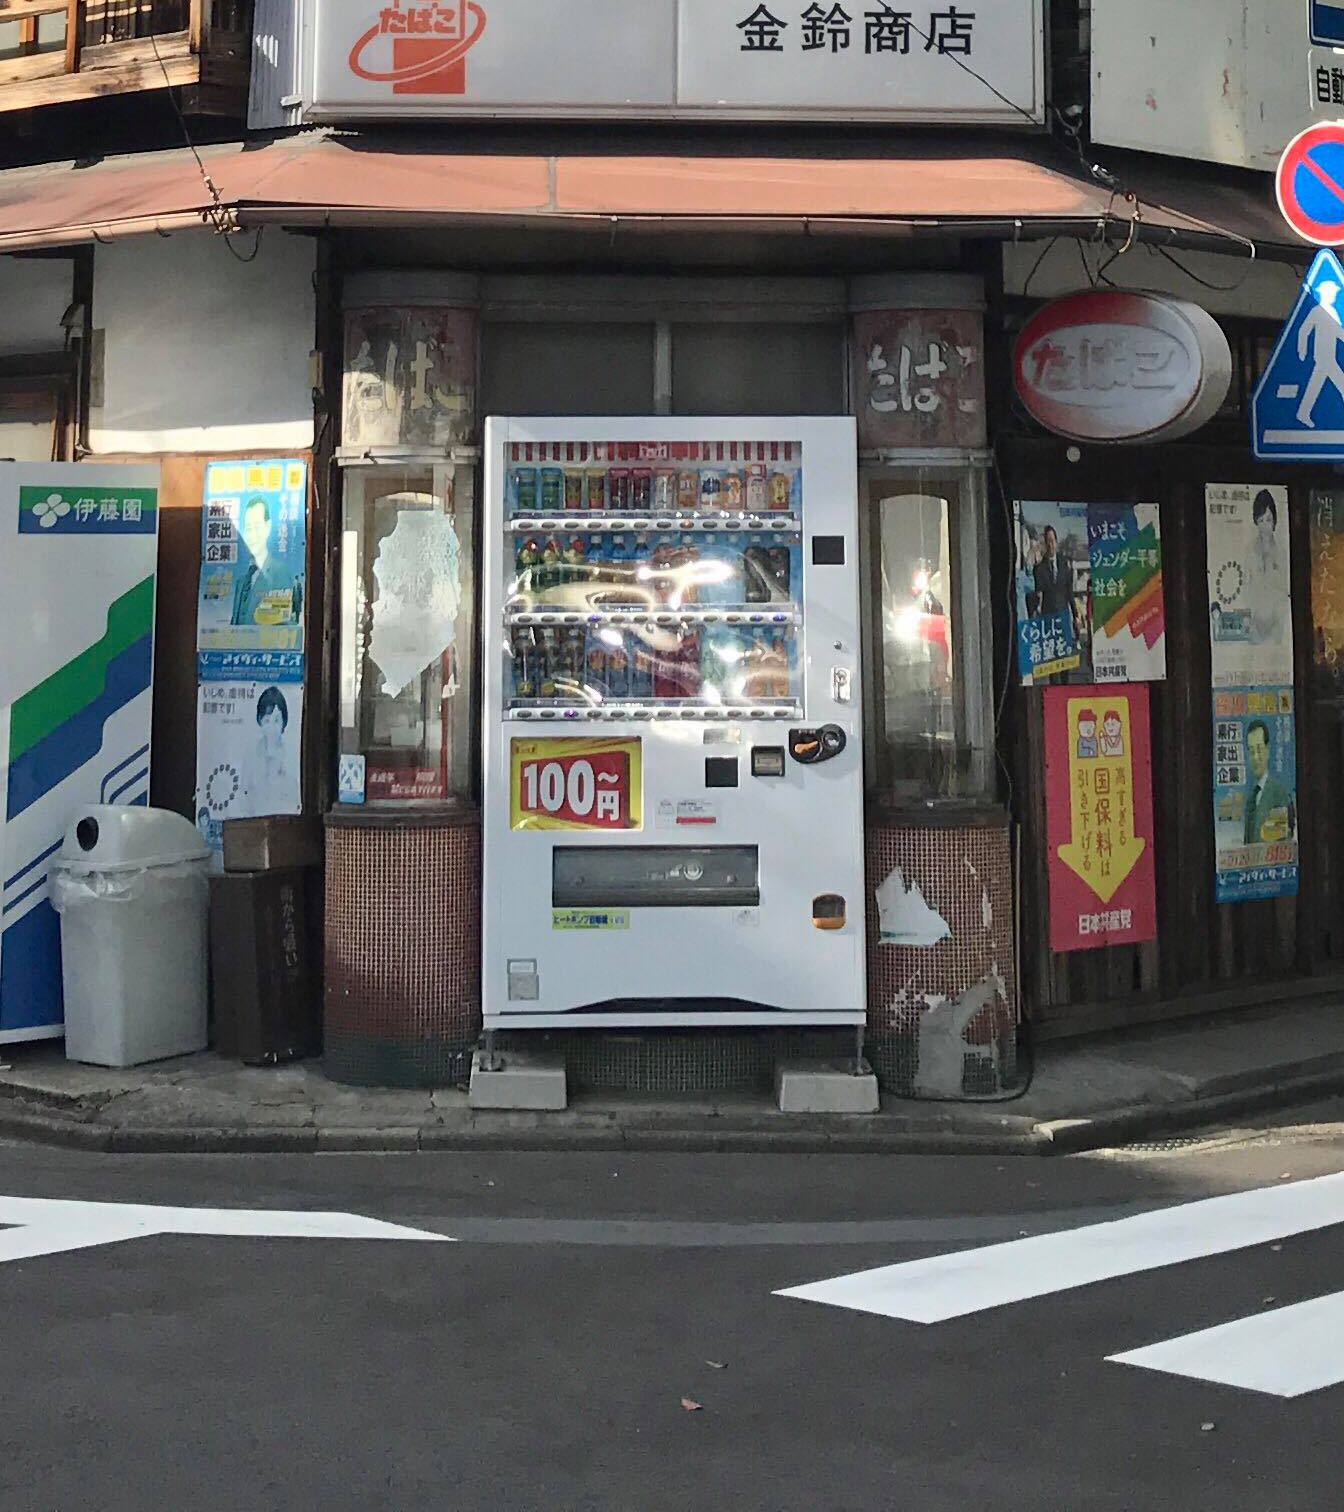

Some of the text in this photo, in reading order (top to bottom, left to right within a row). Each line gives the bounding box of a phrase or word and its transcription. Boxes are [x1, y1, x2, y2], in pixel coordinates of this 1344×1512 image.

[379, 3, 457, 36] たばこ
[735, 1, 976, 56] 金鈴商店
[73, 497, 142, 522] 伊藤園
[1089, 521, 1128, 541] いまこそ
[1092, 548, 1160, 569] ジェンダー平等
[1094, 579, 1128, 598] 社会を
[1021, 617, 1063, 643] くらしに
[1077, 768, 1092, 872] 引き下げる
[1115, 767, 1127, 847] 高すぎる
[1094, 767, 1112, 877] 国保料は
